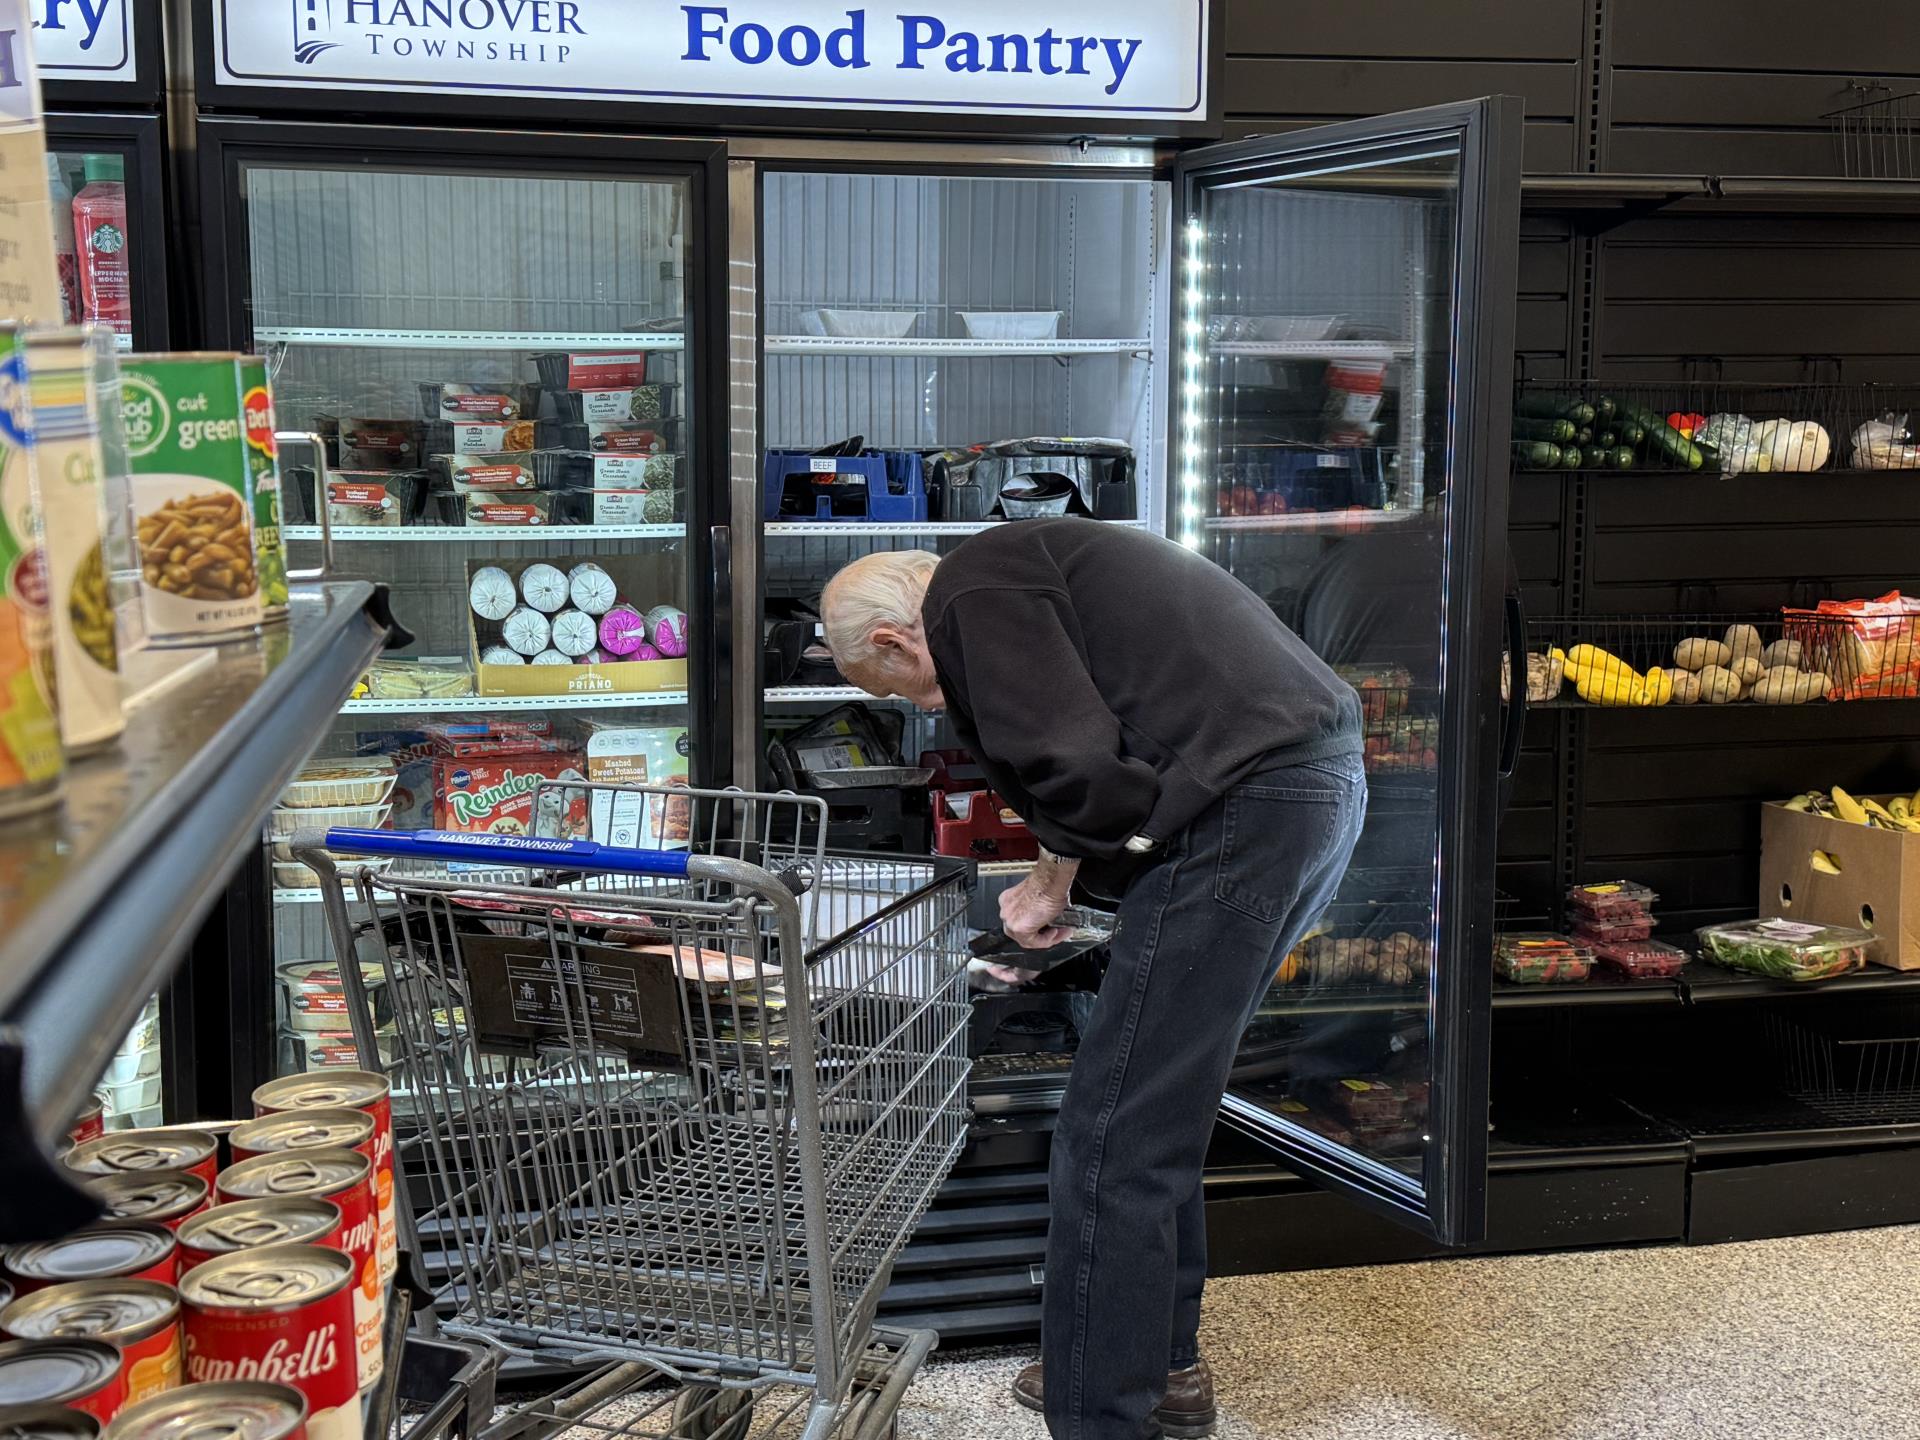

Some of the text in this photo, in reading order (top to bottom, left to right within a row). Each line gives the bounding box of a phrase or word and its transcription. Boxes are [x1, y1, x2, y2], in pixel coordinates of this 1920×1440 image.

[344, 0, 588, 35] HANOVER
[365, 33, 570, 63] TOWNSHIP
[680, 5, 1143, 95] Food Pantry
[176, 392, 208, 411] cut
[178, 419, 239, 450] green
[813, 461, 832, 470] BEEF
[568, 679, 612, 690] PRIANO
[604, 759, 632, 768] Mashed
[592, 767, 645, 777] Sweet Potatoes
[437, 834, 574, 850] HANOVER TOWNSHIP
[552, 959, 601, 976] ARING
[202, 1316, 290, 1331] ONDENSED
